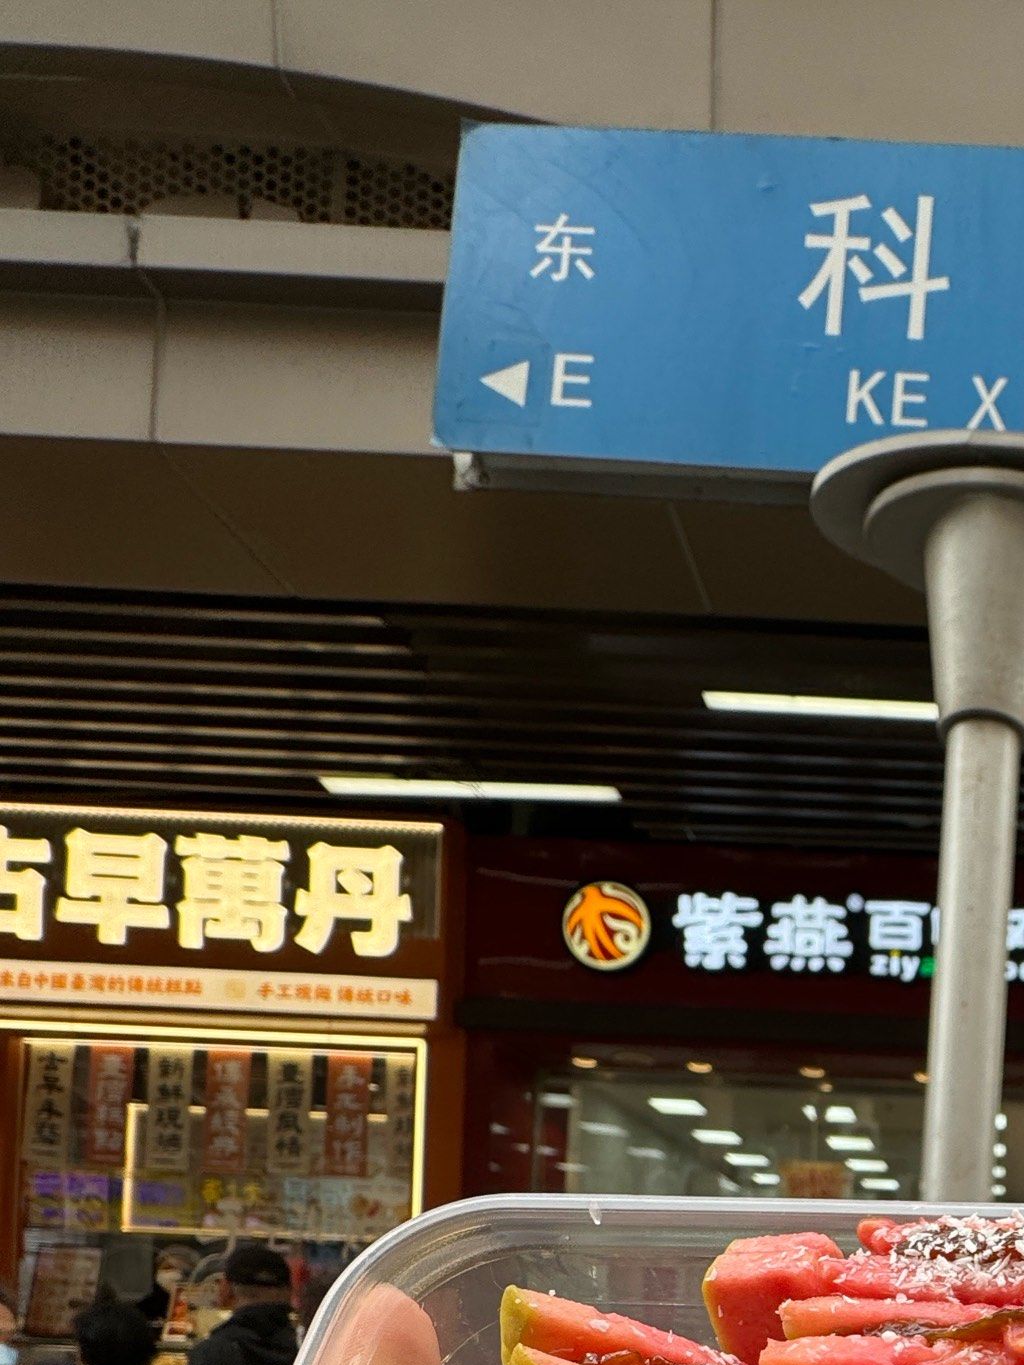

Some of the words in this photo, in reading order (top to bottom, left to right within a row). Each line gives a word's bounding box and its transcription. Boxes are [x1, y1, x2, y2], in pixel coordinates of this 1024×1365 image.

[529, 213, 596, 282] 东
[549, 352, 595, 408] E
[845, 368, 931, 428] KE
